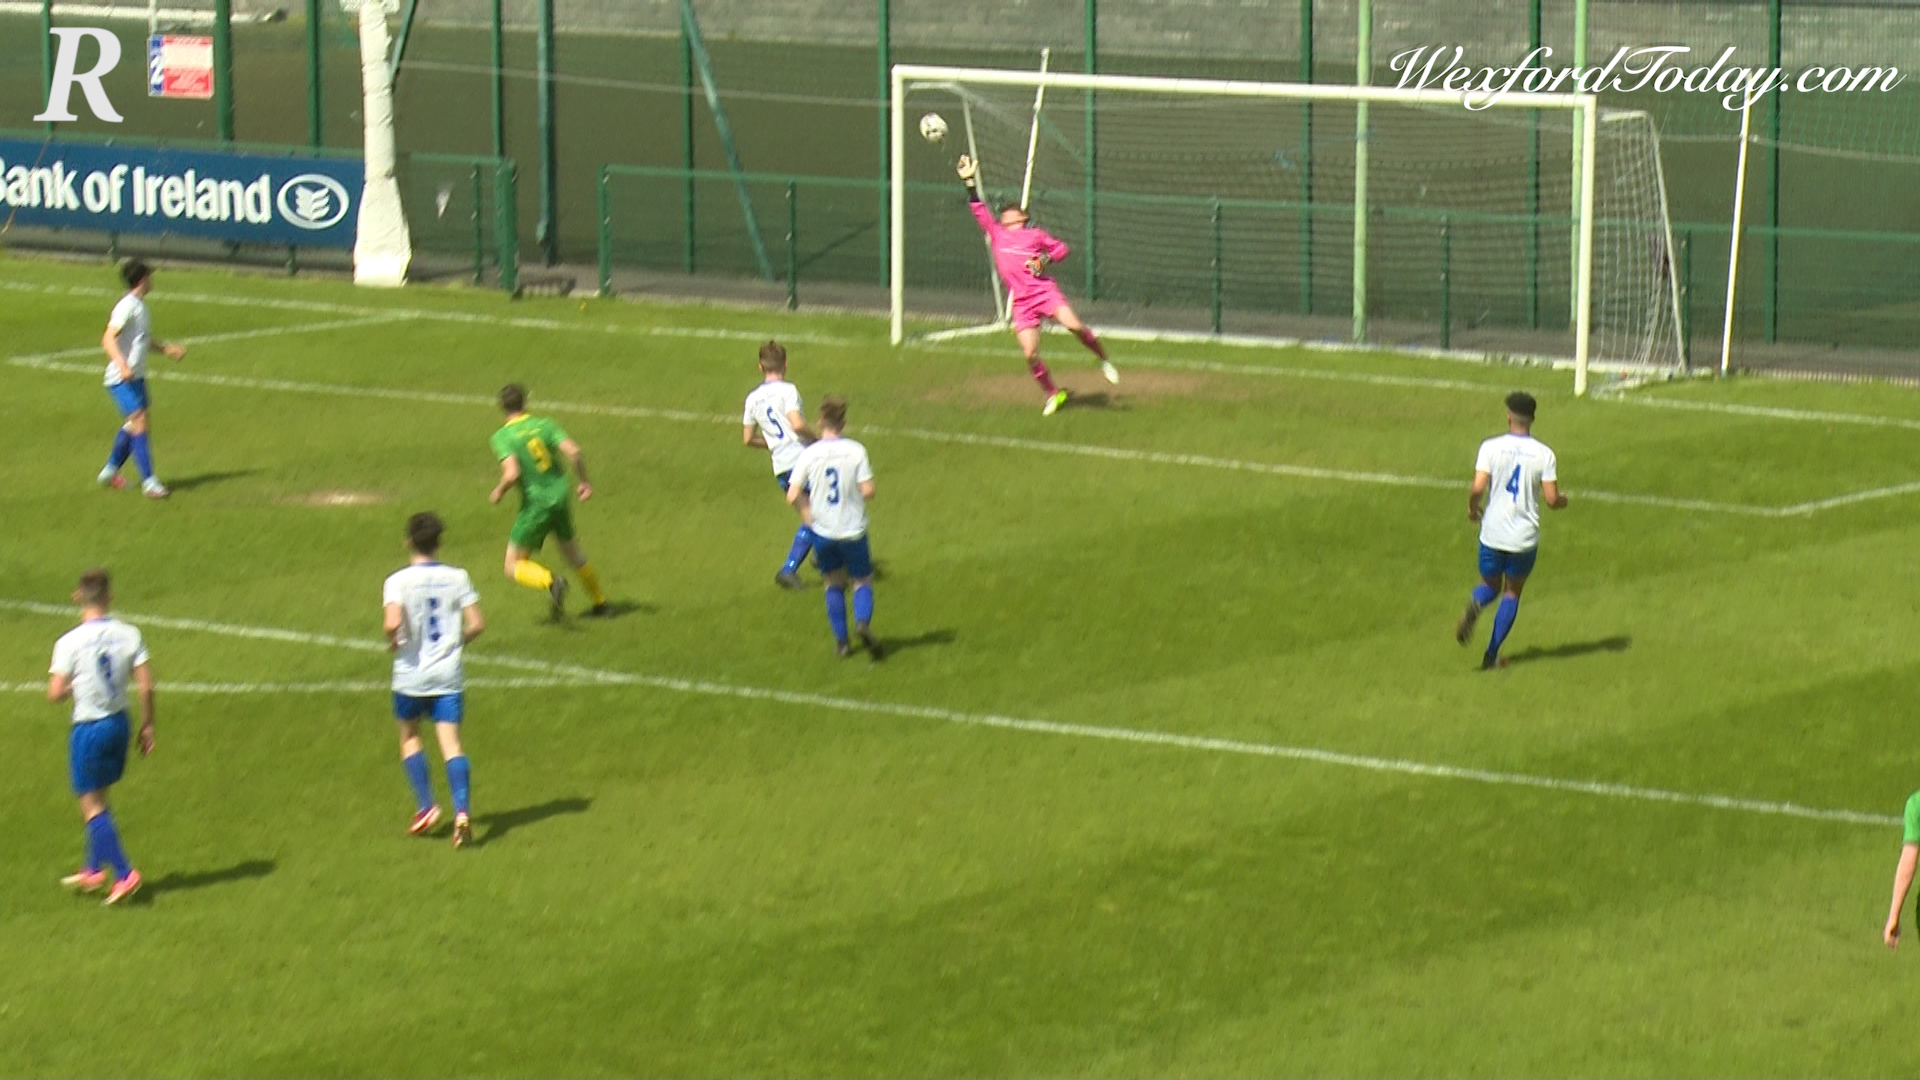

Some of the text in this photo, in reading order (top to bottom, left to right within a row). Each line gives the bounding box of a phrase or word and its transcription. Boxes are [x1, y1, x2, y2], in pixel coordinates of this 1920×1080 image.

[82, 164, 129, 213] of
[132, 166, 272, 224] Ireland
[765, 406, 785, 440] 5
[824, 466, 840, 506] 3
[1505, 463, 1522, 503] 4
